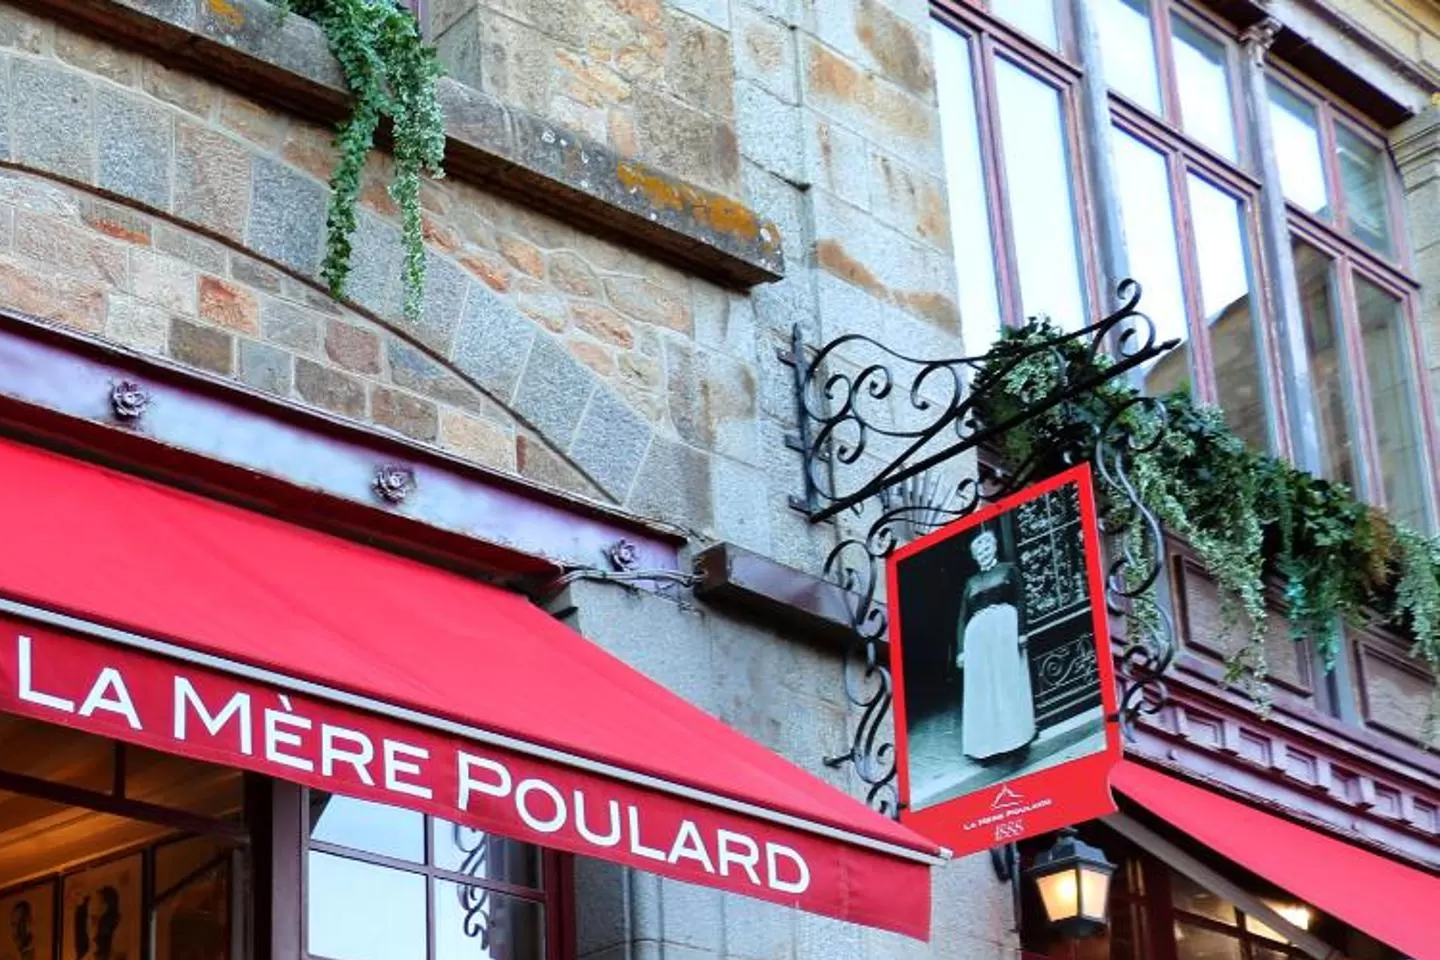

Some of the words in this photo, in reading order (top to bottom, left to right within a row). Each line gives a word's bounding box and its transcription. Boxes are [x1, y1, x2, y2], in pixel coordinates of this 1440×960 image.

[17, 634, 143, 731] LA
[172, 674, 434, 800] MÈRE
[456, 749, 811, 894] POULARD
